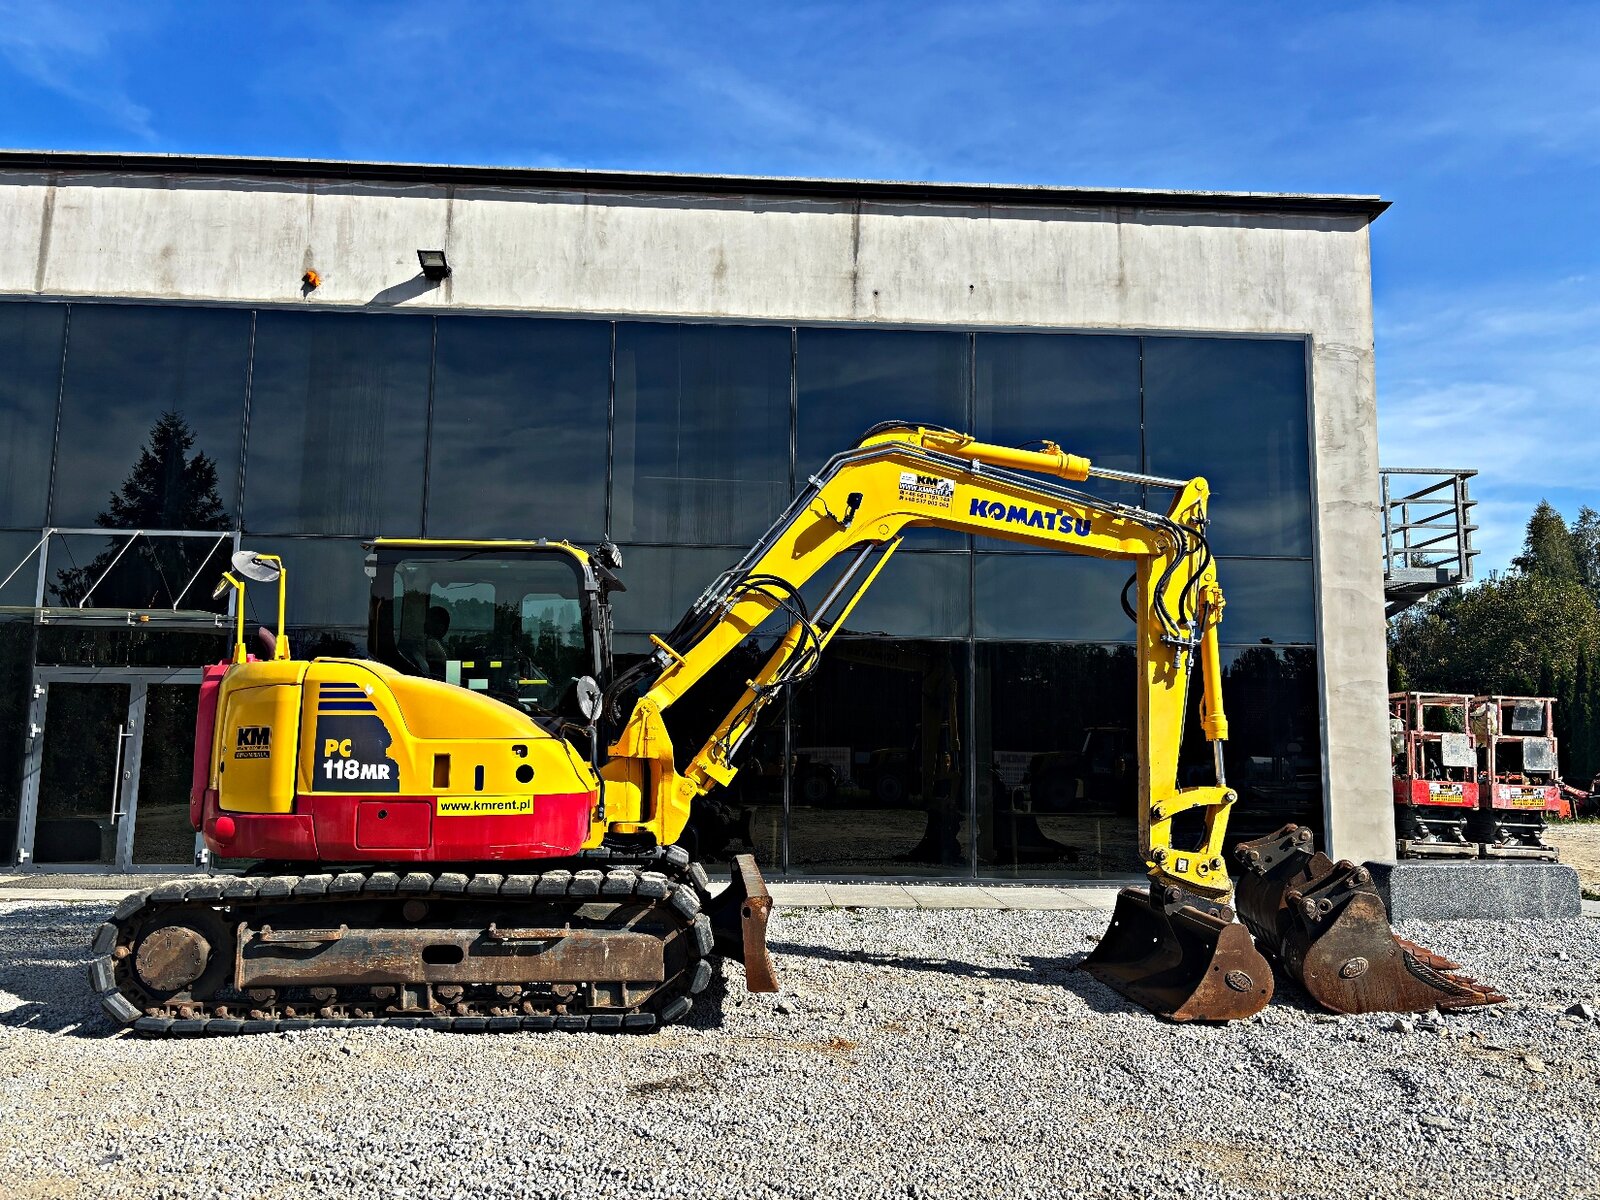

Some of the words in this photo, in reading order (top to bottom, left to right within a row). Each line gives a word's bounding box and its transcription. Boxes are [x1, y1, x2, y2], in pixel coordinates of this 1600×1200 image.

[917, 475, 938, 486] KM
[970, 498, 1092, 537] KOMATSU
[238, 726, 270, 746] KM
[325, 738, 352, 757] PC
[441, 799, 530, 811] www.kmrent.pl
